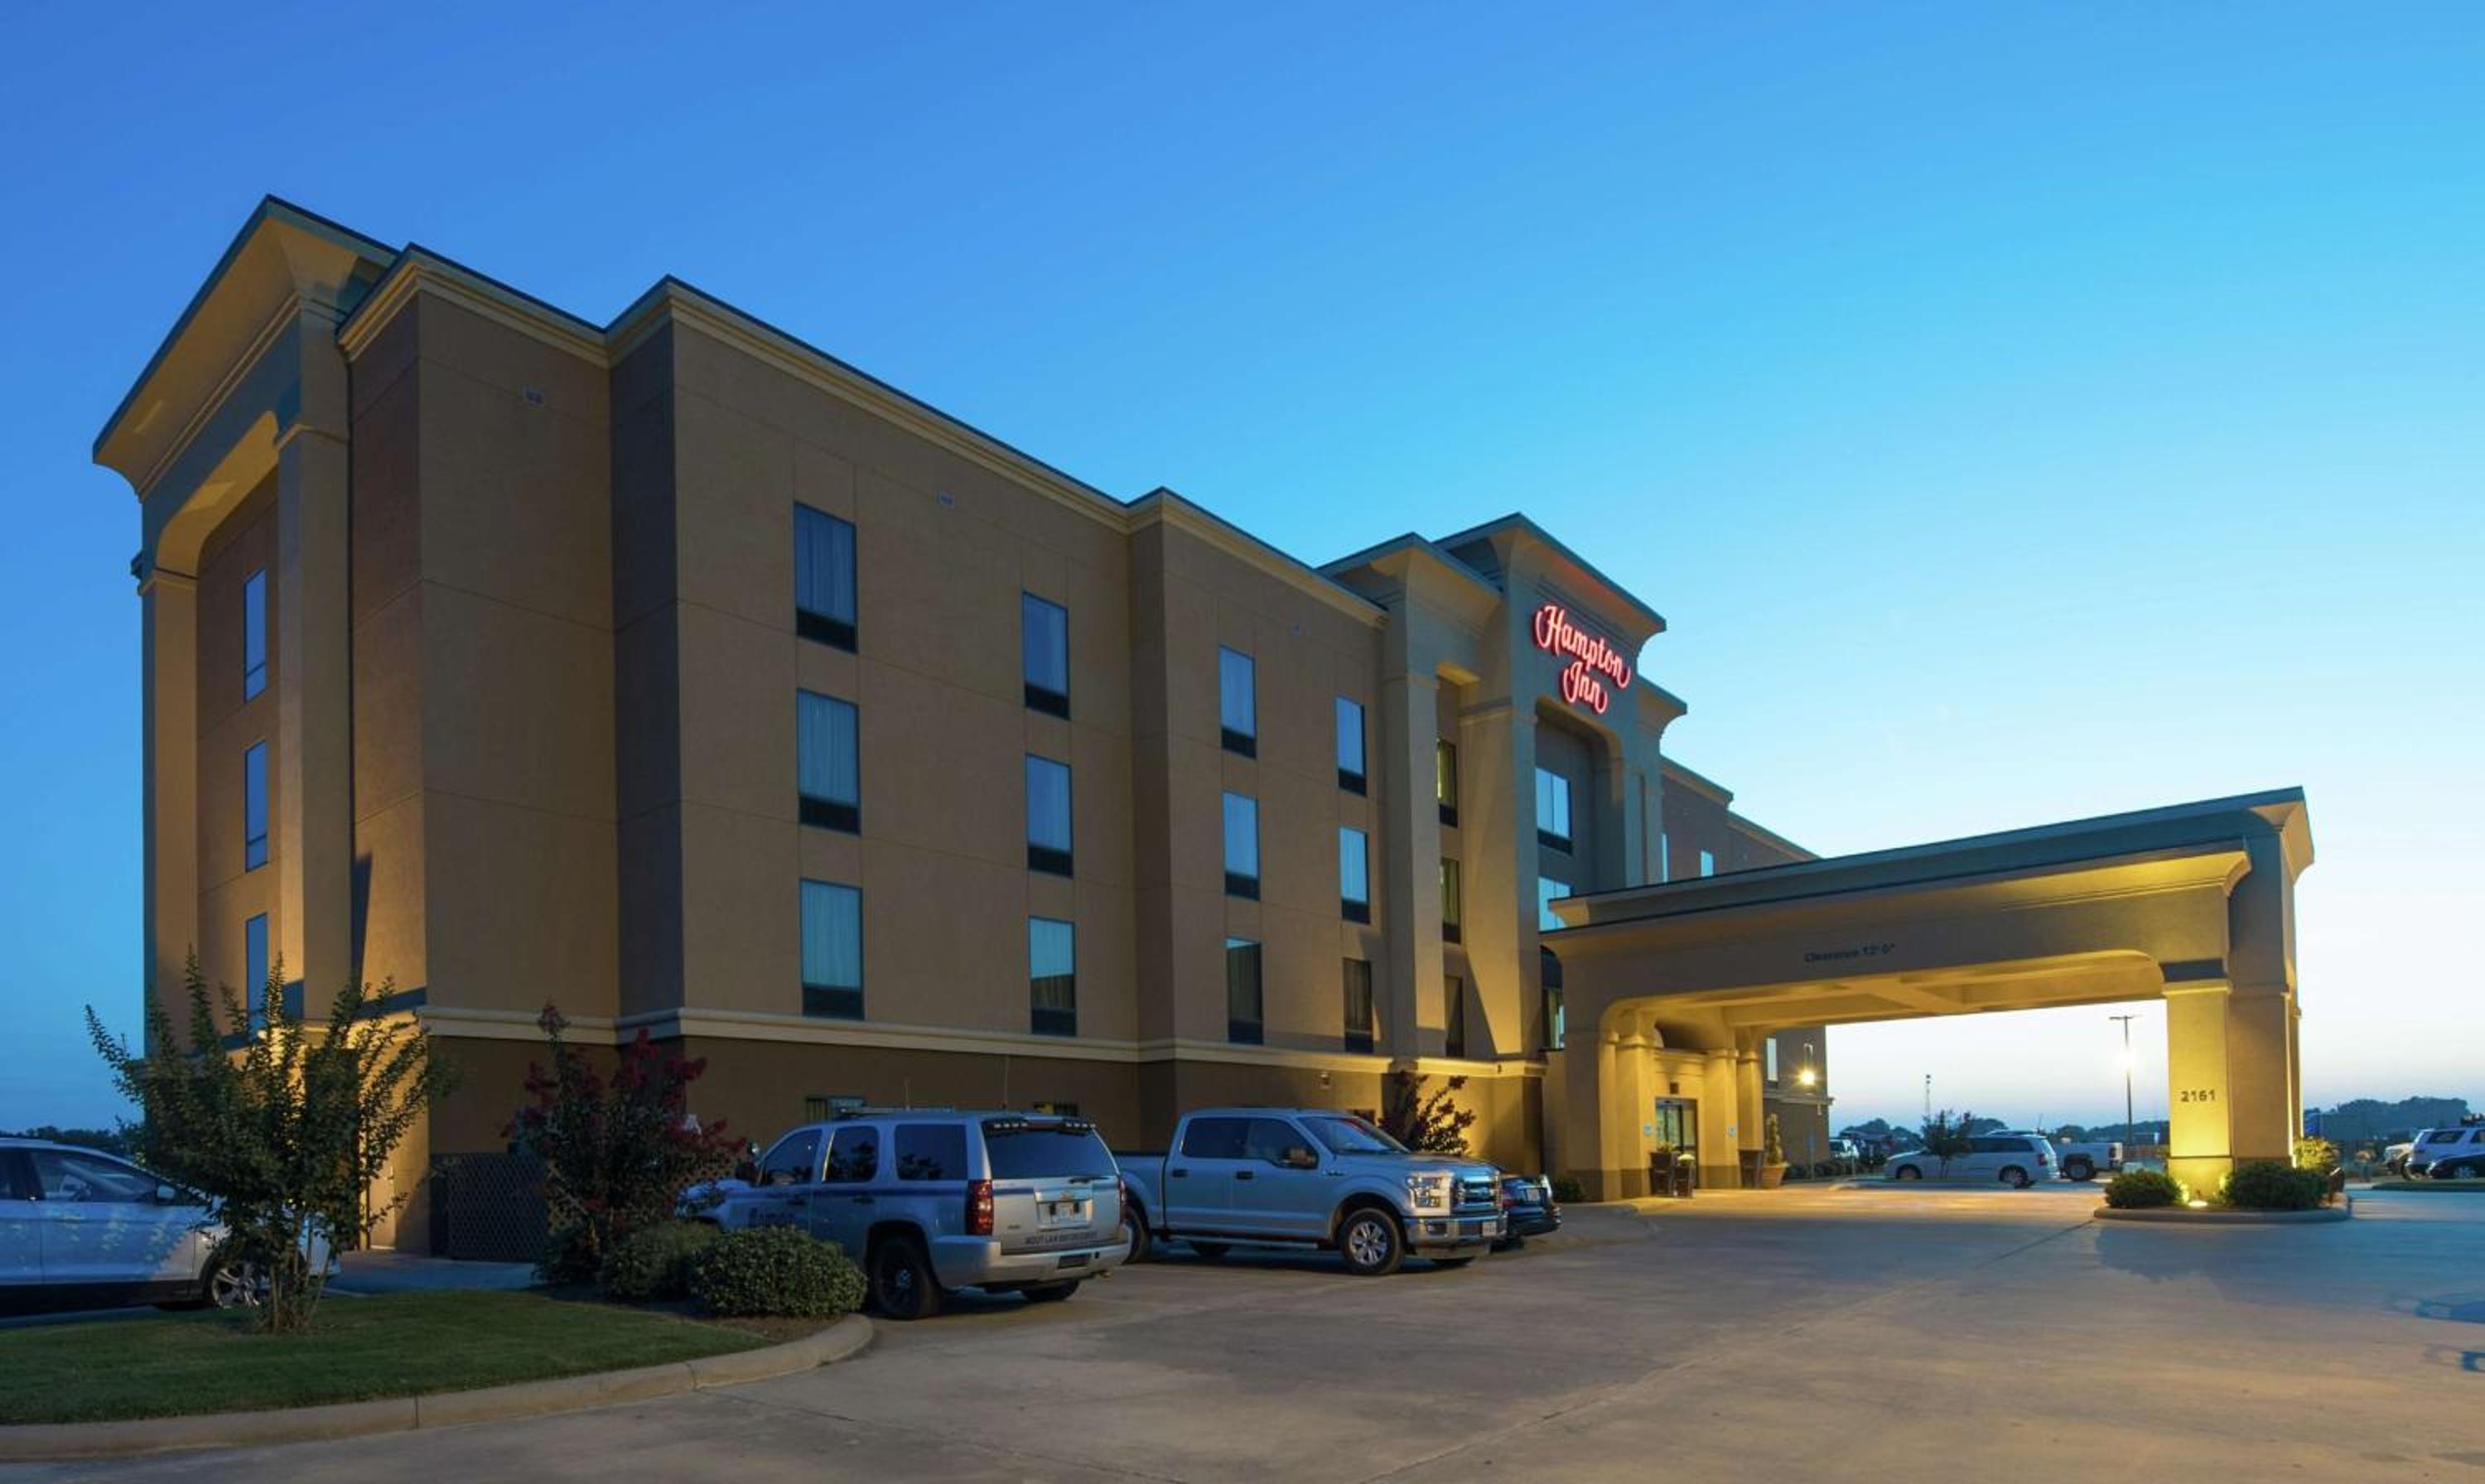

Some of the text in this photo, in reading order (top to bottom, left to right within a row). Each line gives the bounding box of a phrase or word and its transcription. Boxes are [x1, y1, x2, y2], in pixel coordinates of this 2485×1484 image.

[1535, 605, 1631, 689] Hampton
[1563, 661, 1609, 714] Inn
[2180, 1089, 2216, 1102] 2161
